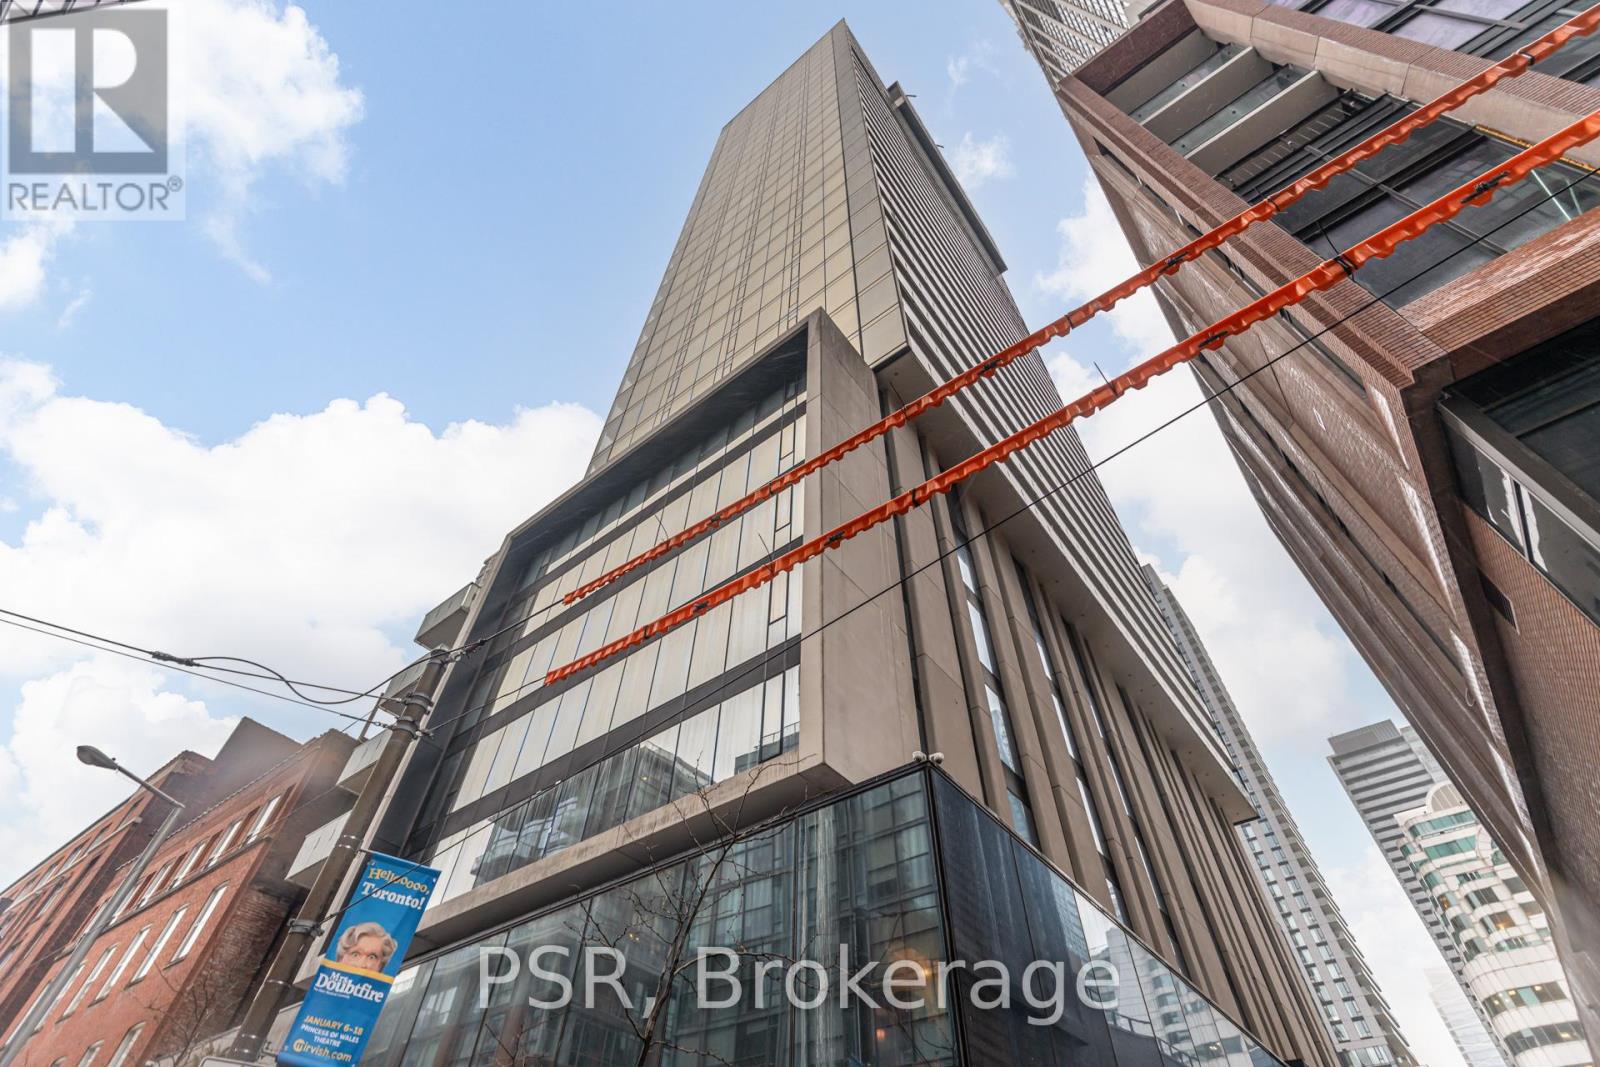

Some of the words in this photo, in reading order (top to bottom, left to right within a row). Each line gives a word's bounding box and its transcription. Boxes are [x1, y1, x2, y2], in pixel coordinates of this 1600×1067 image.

[361, 881, 426, 910] Toronto!
[314, 973, 384, 1003] Doubtfire
[304, 1015, 344, 1029] JANUARY
[301, 1023, 329, 1037] PRINCESS
[329, 1031, 339, 1039] OF
[340, 1033, 360, 1044] WALES
[313, 1035, 342, 1048] THEATRE
